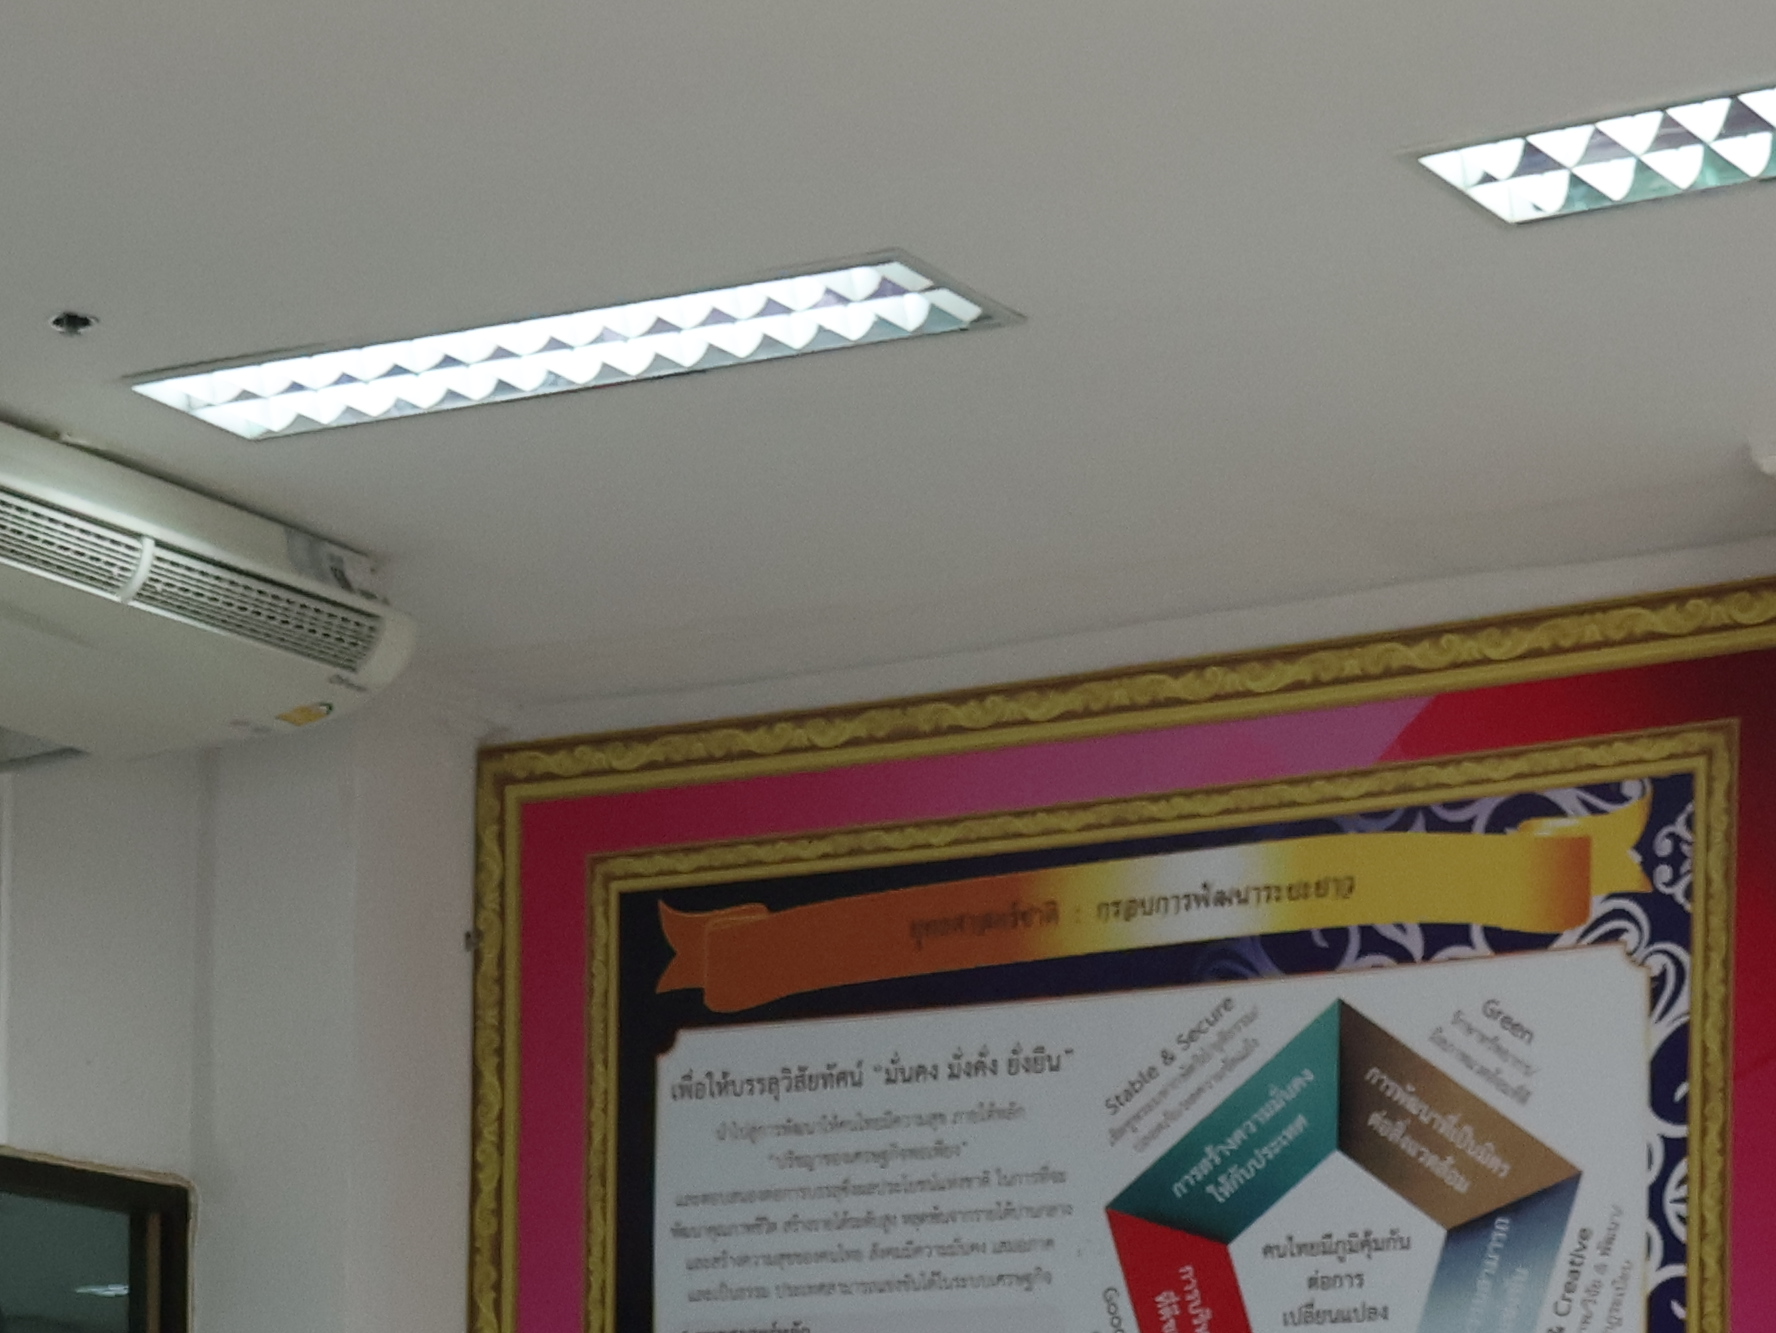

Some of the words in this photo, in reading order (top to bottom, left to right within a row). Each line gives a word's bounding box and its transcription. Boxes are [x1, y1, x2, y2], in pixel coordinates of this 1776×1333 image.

[1104, 1064, 1160, 1116] Stable
[1160, 1047, 1177, 1067] &
[1176, 996, 1237, 1051] Secure
[1481, 998, 1535, 1047] Green
[1553, 1226, 1595, 1319] Creative
